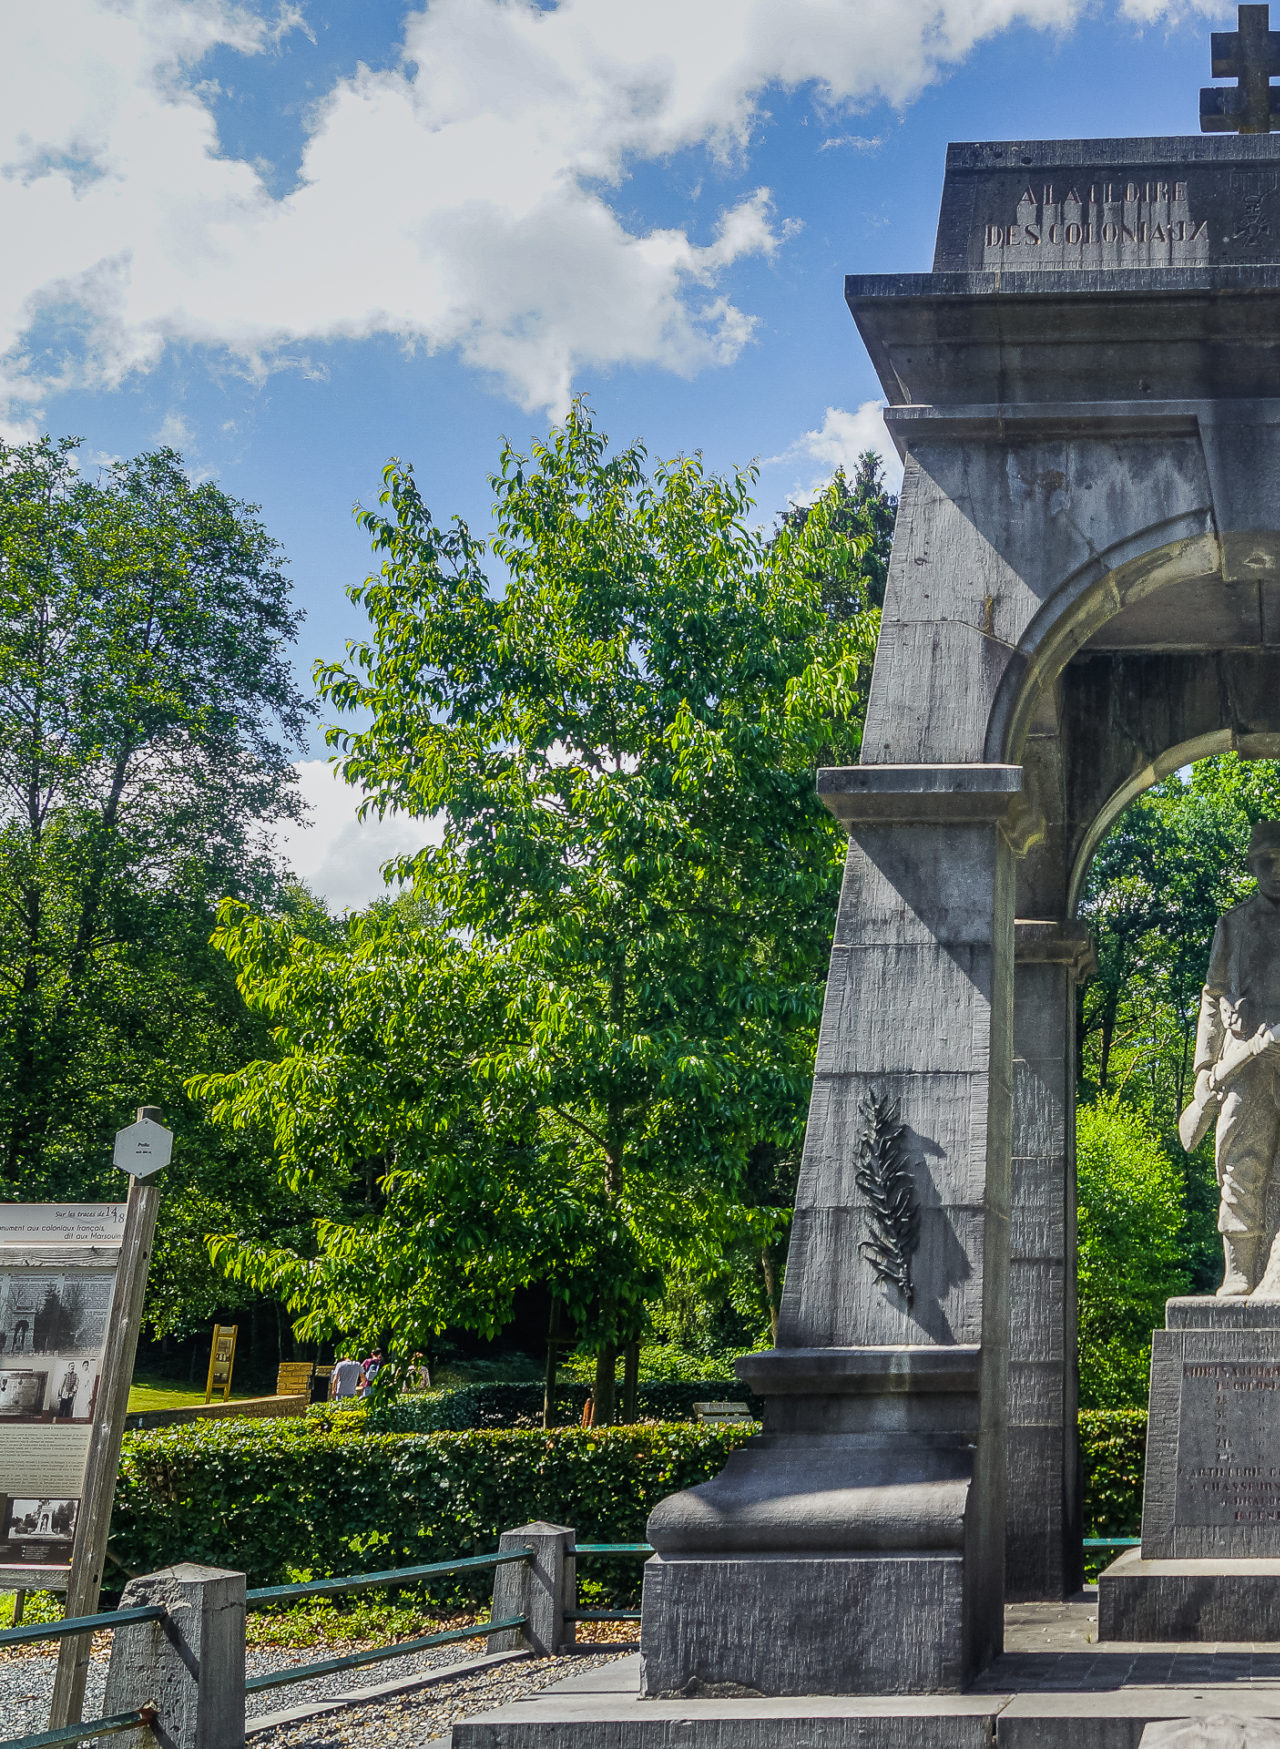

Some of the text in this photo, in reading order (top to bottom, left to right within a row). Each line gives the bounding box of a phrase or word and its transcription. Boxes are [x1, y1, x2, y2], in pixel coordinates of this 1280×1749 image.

[1019, 184, 1038, 205] A
[984, 219, 1209, 248] DES COLONIAUX
[55, 1210, 66, 1218] Sur
[67, 1210, 76, 1218] les
[97, 1210, 104, 1218] de
[105, 1206, 118, 1217] 14
[113, 1212, 125, 1223] 18
[41, 1224, 75, 1232] coloniaux
[64, 1232, 73, 1240] dit
